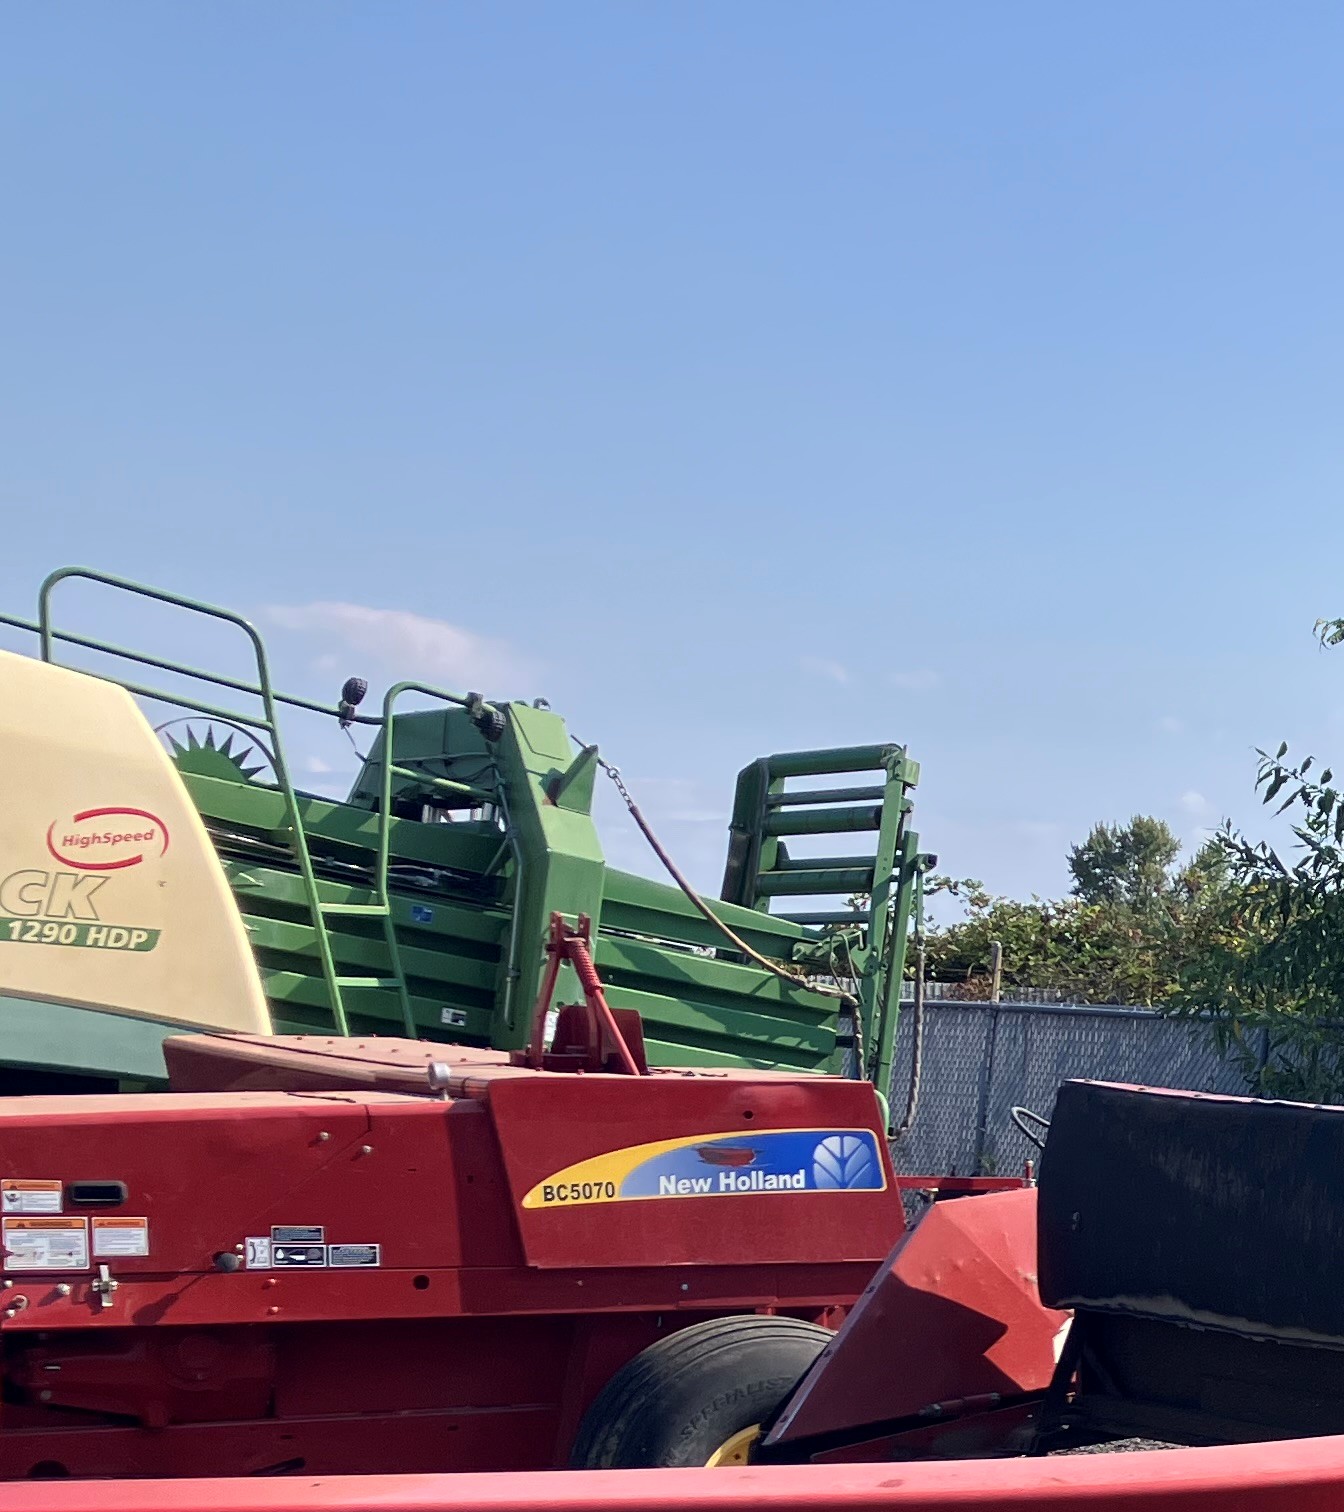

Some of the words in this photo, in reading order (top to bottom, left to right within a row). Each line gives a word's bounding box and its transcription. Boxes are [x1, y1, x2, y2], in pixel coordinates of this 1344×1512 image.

[62, 828, 155, 849] HighSpeed
[8, 921, 77, 943] 1290
[85, 926, 148, 949] HDP
[543, 1182, 615, 1202] BC5070
[659, 1175, 712, 1195] New
[719, 1170, 805, 1192] Holland
